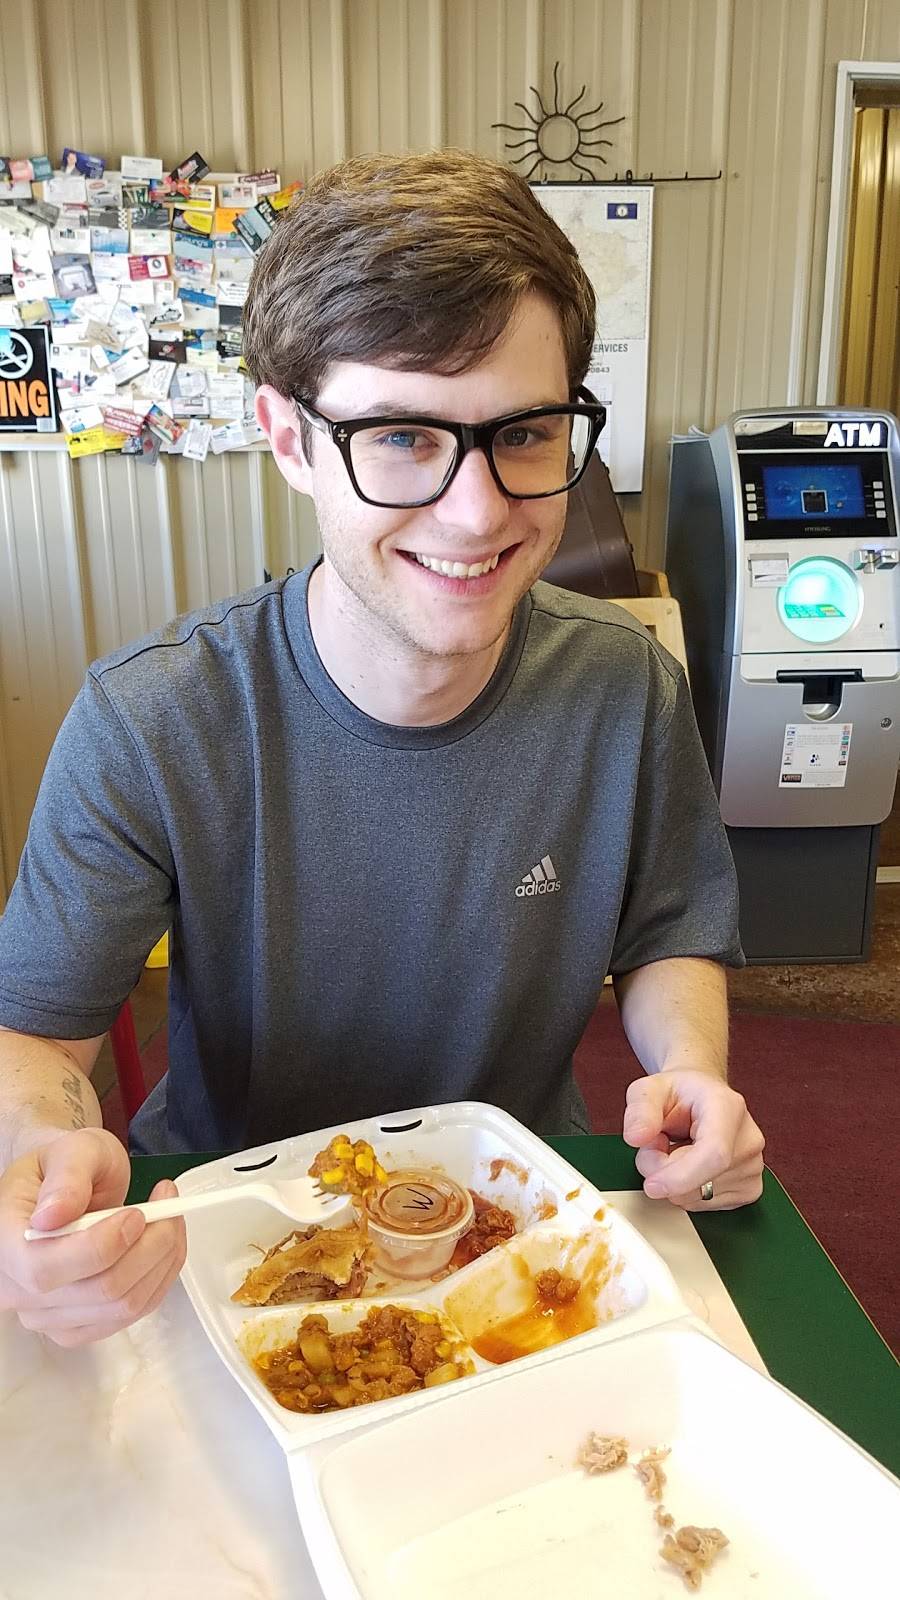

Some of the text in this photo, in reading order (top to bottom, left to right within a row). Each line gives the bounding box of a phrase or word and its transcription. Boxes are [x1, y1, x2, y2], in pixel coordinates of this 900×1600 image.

[593, 343, 628, 353] ERVICES
[0, 379, 50, 417] ING
[824, 422, 881, 447] ATM
[515, 879, 561, 897] adidas
